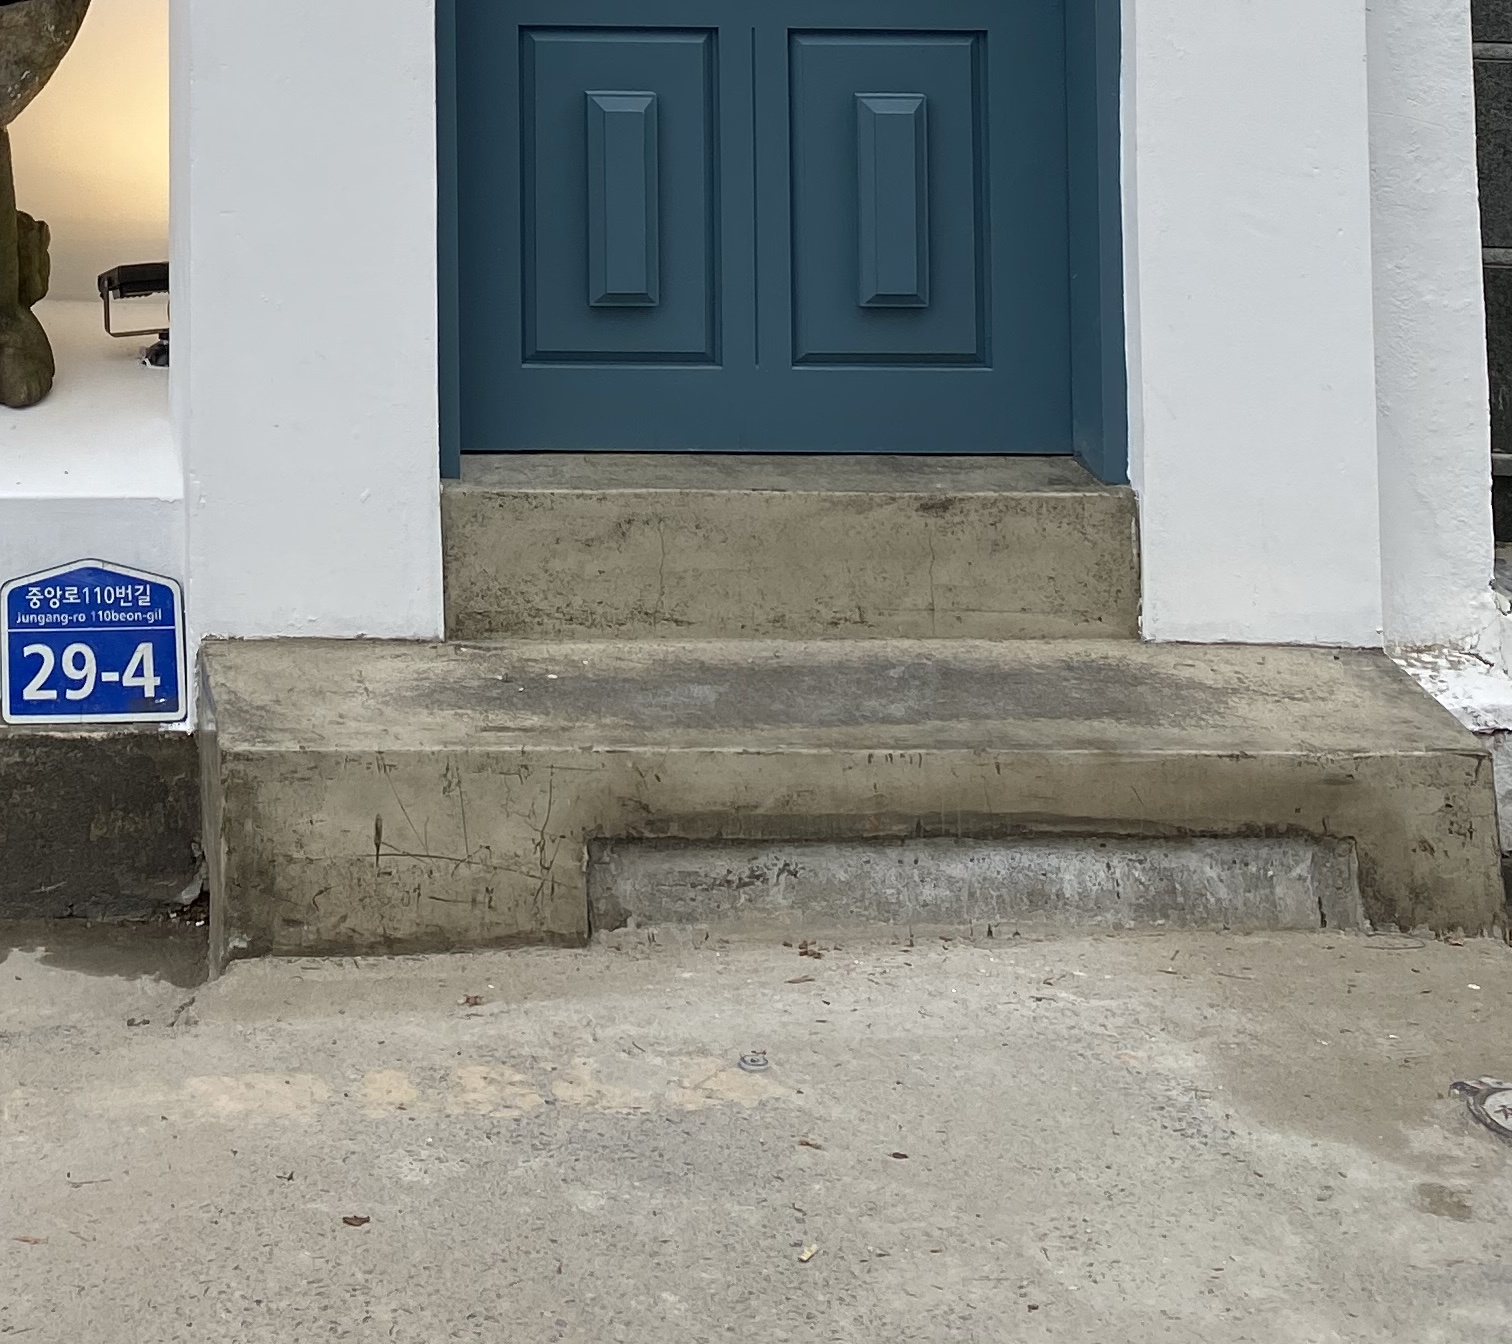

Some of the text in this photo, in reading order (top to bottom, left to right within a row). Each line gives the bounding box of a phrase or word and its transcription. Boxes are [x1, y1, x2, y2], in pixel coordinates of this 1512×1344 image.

[25, 584, 152, 609] 중앙로110번길
[16, 608, 162, 626] Jungang-ro 110beon-gil
[22, 641, 161, 701] 29-4
